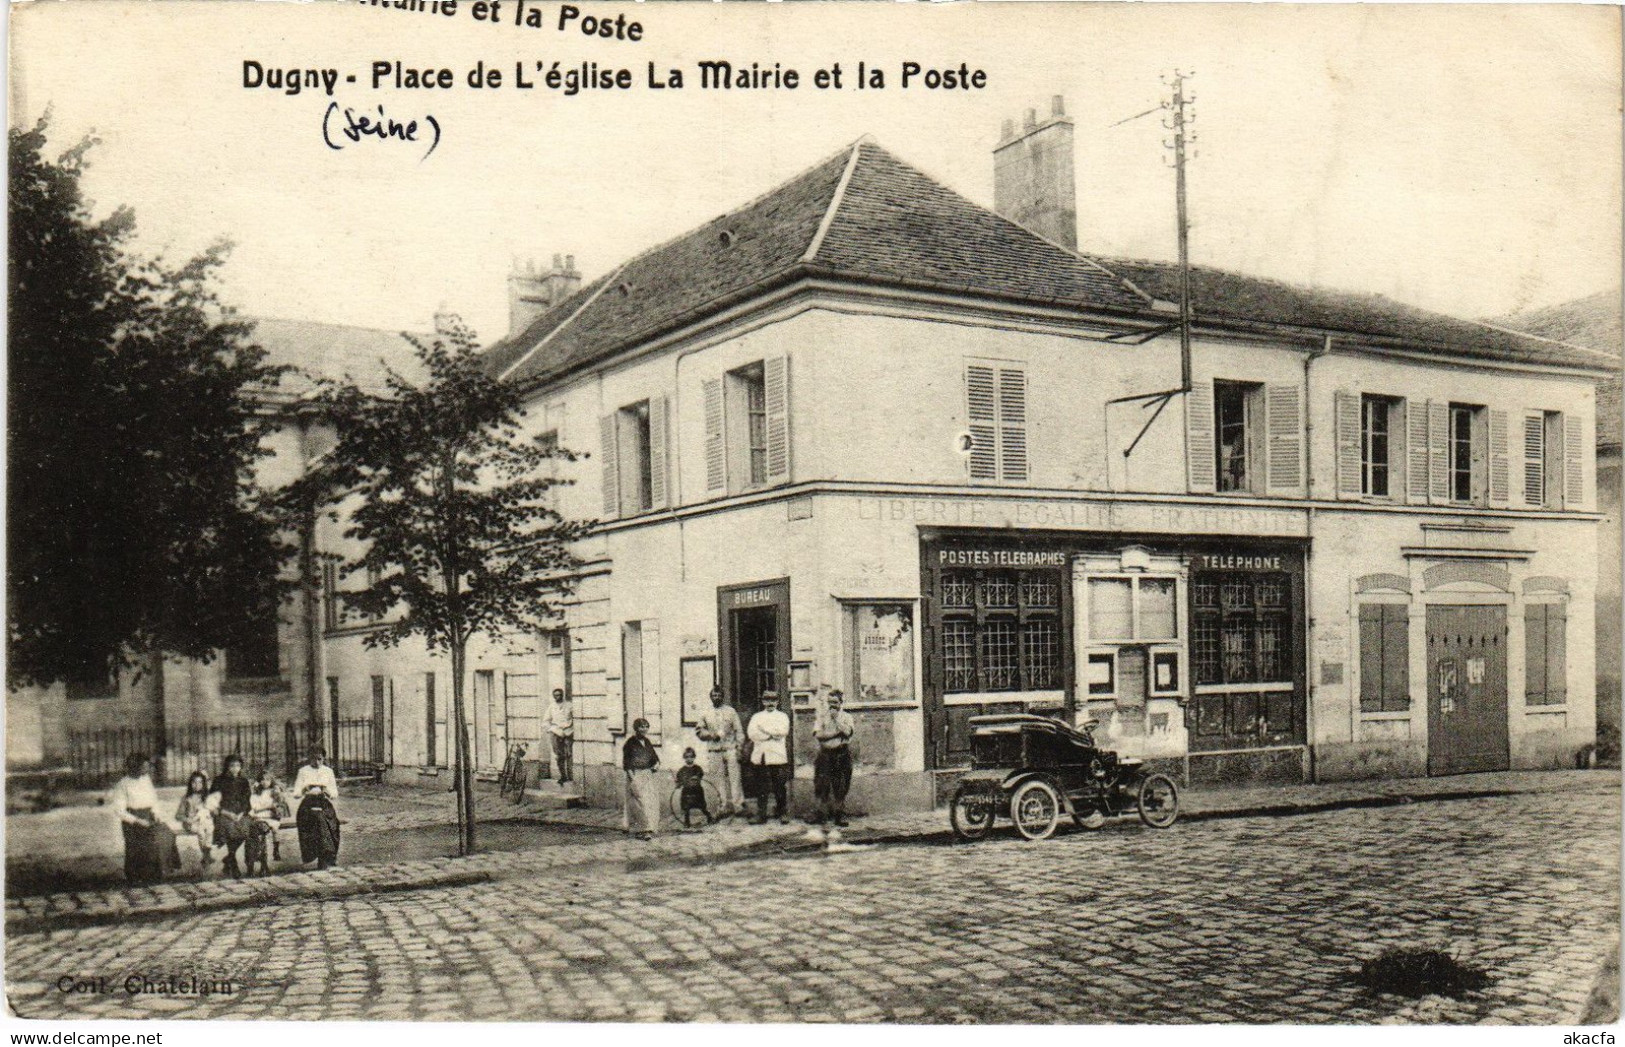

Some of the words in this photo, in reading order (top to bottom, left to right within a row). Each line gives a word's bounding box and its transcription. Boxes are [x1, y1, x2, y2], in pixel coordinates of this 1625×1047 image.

[939, 550, 989, 565] POSTES
[993, 551, 1066, 566] TELEGRAPHES
[734, 589, 771, 605] BUREAU
